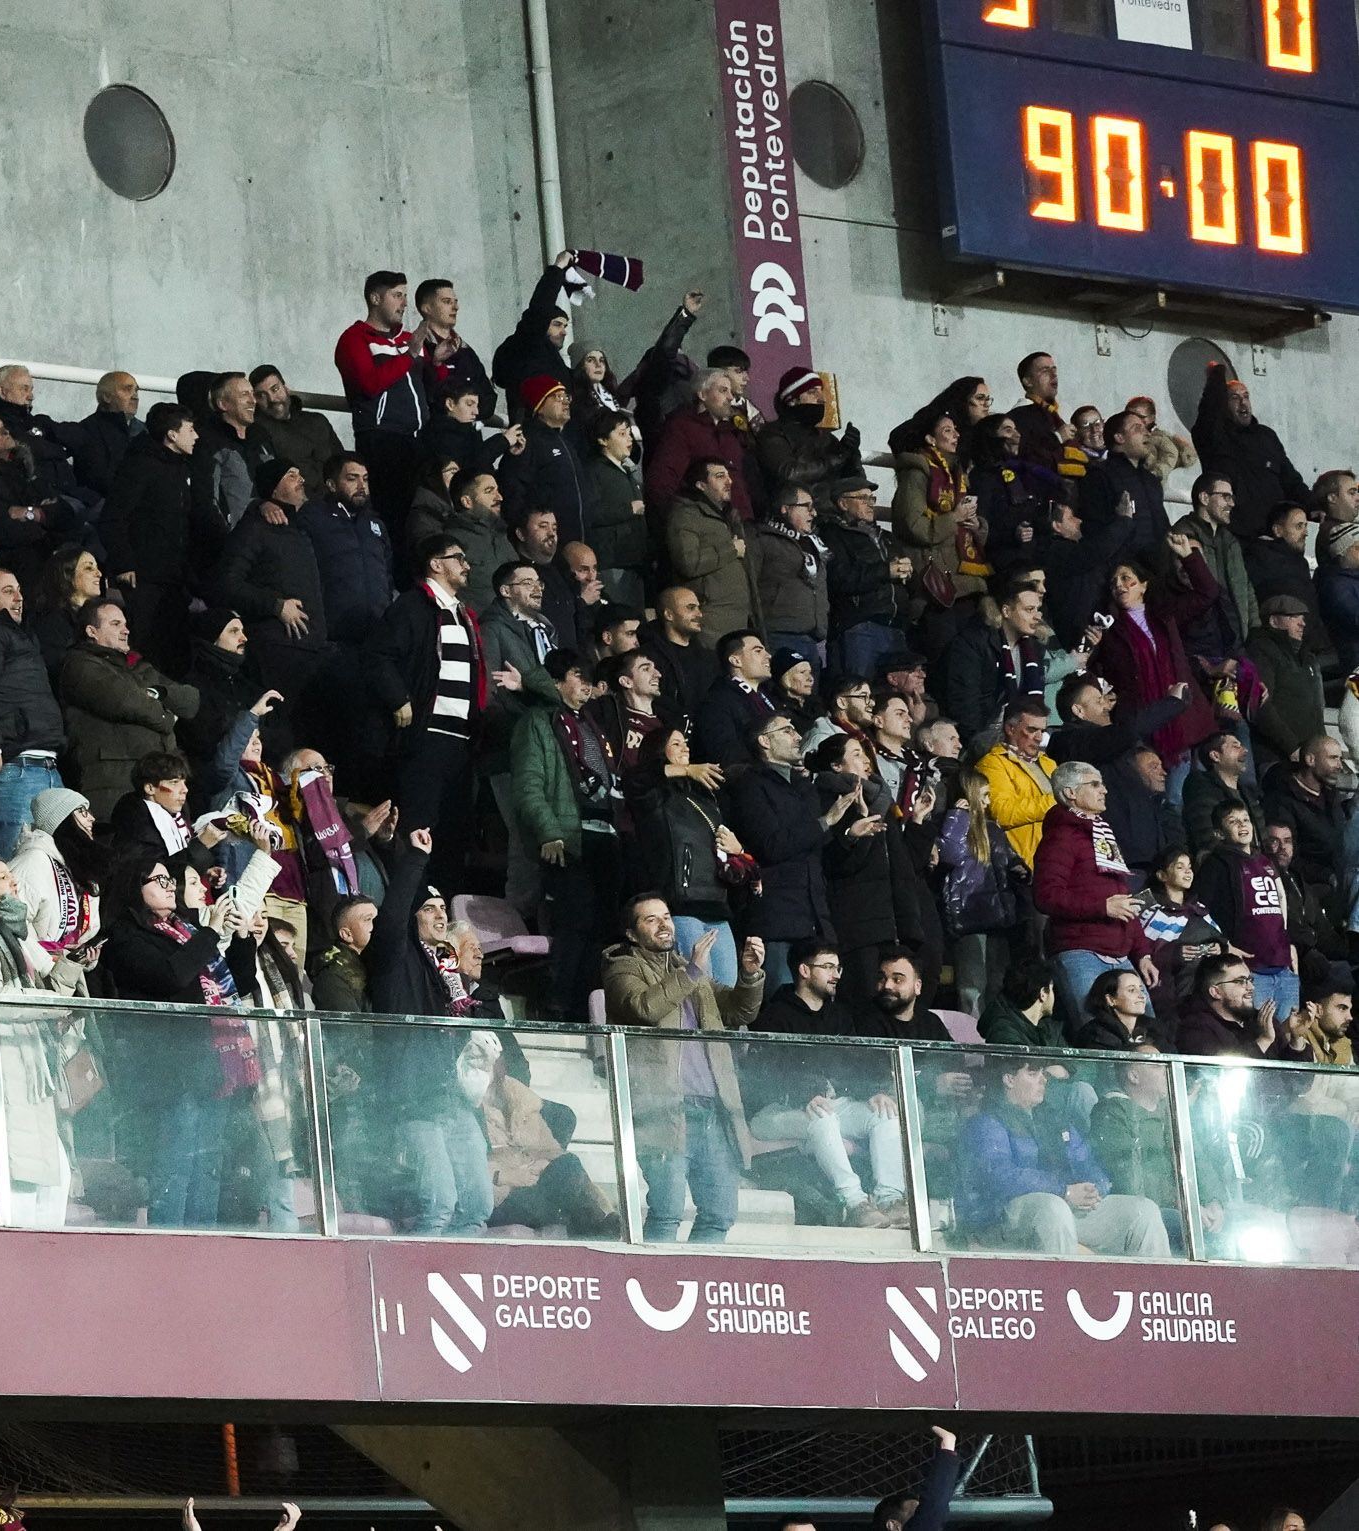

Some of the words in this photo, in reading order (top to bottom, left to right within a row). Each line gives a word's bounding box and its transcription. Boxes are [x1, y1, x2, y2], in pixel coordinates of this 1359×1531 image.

[723, 20, 768, 240] Deputación
[754, 24, 792, 243] Pontevedra
[493, 1274, 601, 1301] DEPORTE
[705, 1281, 786, 1308] GALICIA
[946, 1287, 1045, 1312] DEPORTE
[1139, 1291, 1213, 1316] GALICIA
[495, 1304, 592, 1330] GALEGO
[706, 1311, 811, 1335] SAUDABLE
[948, 1317, 1036, 1340] GALEGO
[1141, 1318, 1237, 1343] SAUDABLE
